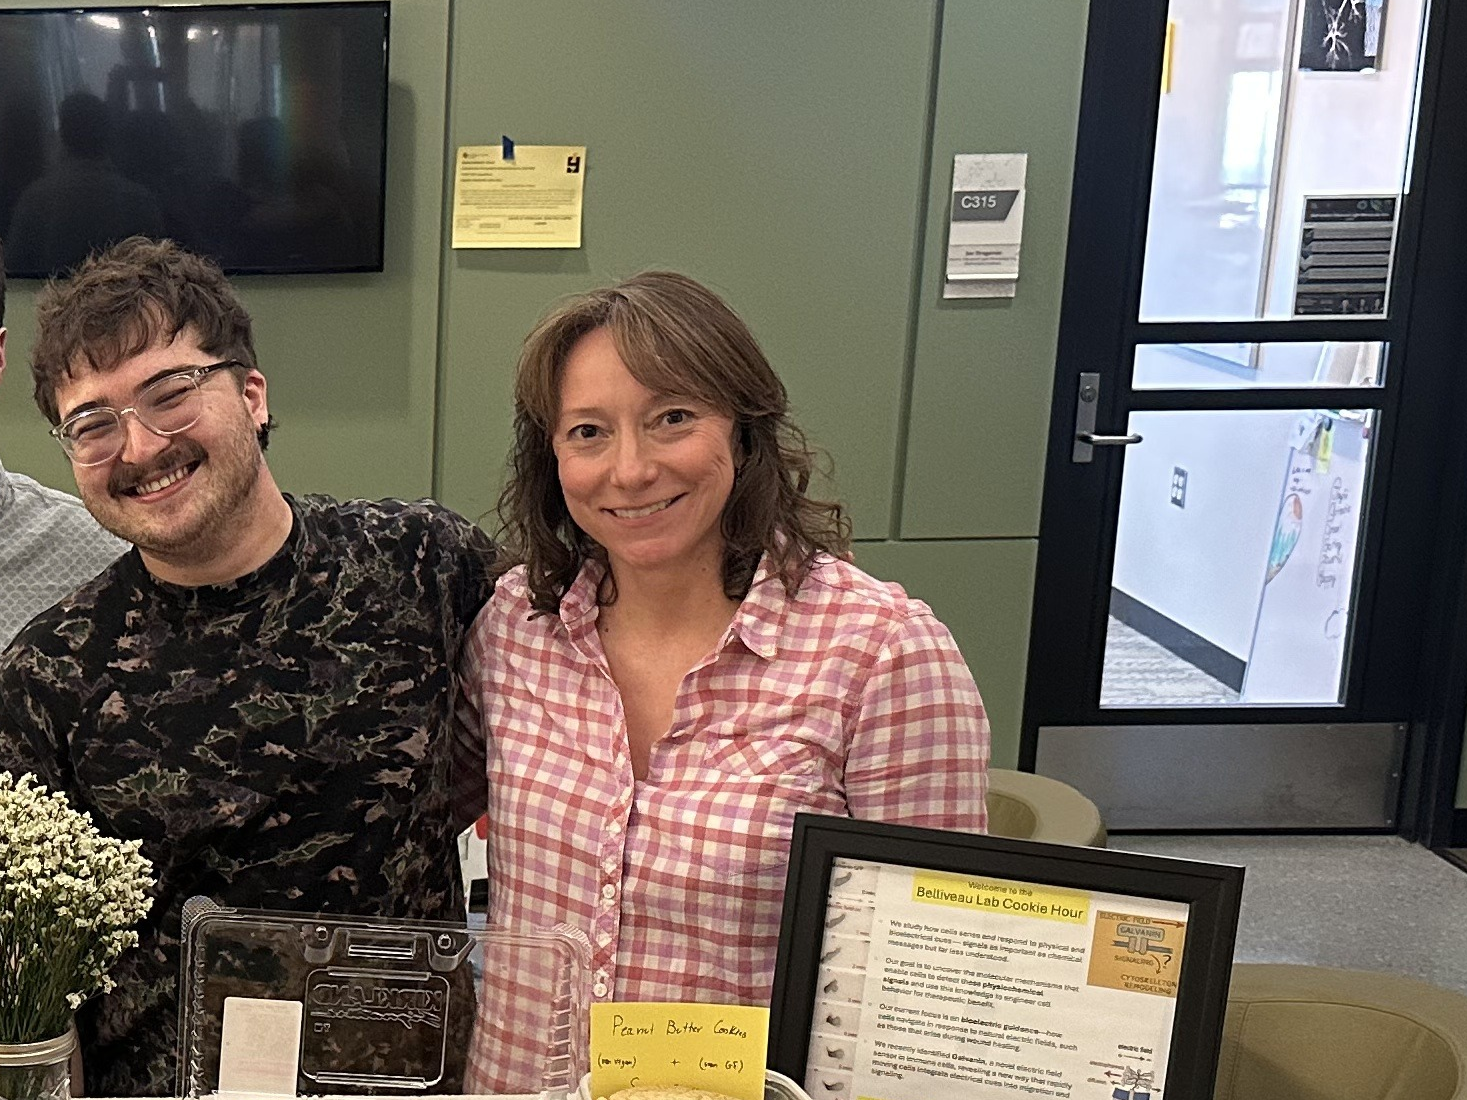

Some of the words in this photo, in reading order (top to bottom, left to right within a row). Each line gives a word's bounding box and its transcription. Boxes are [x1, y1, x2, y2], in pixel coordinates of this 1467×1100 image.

[961, 196, 997, 209] C315
[916, 886, 973, 903] Belliveau
[976, 894, 999, 907] Lab
[1002, 898, 1047, 914] Cookie
[1050, 904, 1084, 918] Hour
[1120, 926, 1162, 938] GALVANIN
[613, 1014, 655, 1036] Peanut
[666, 1019, 703, 1036] Butter
[714, 1020, 747, 1039] Cookies
